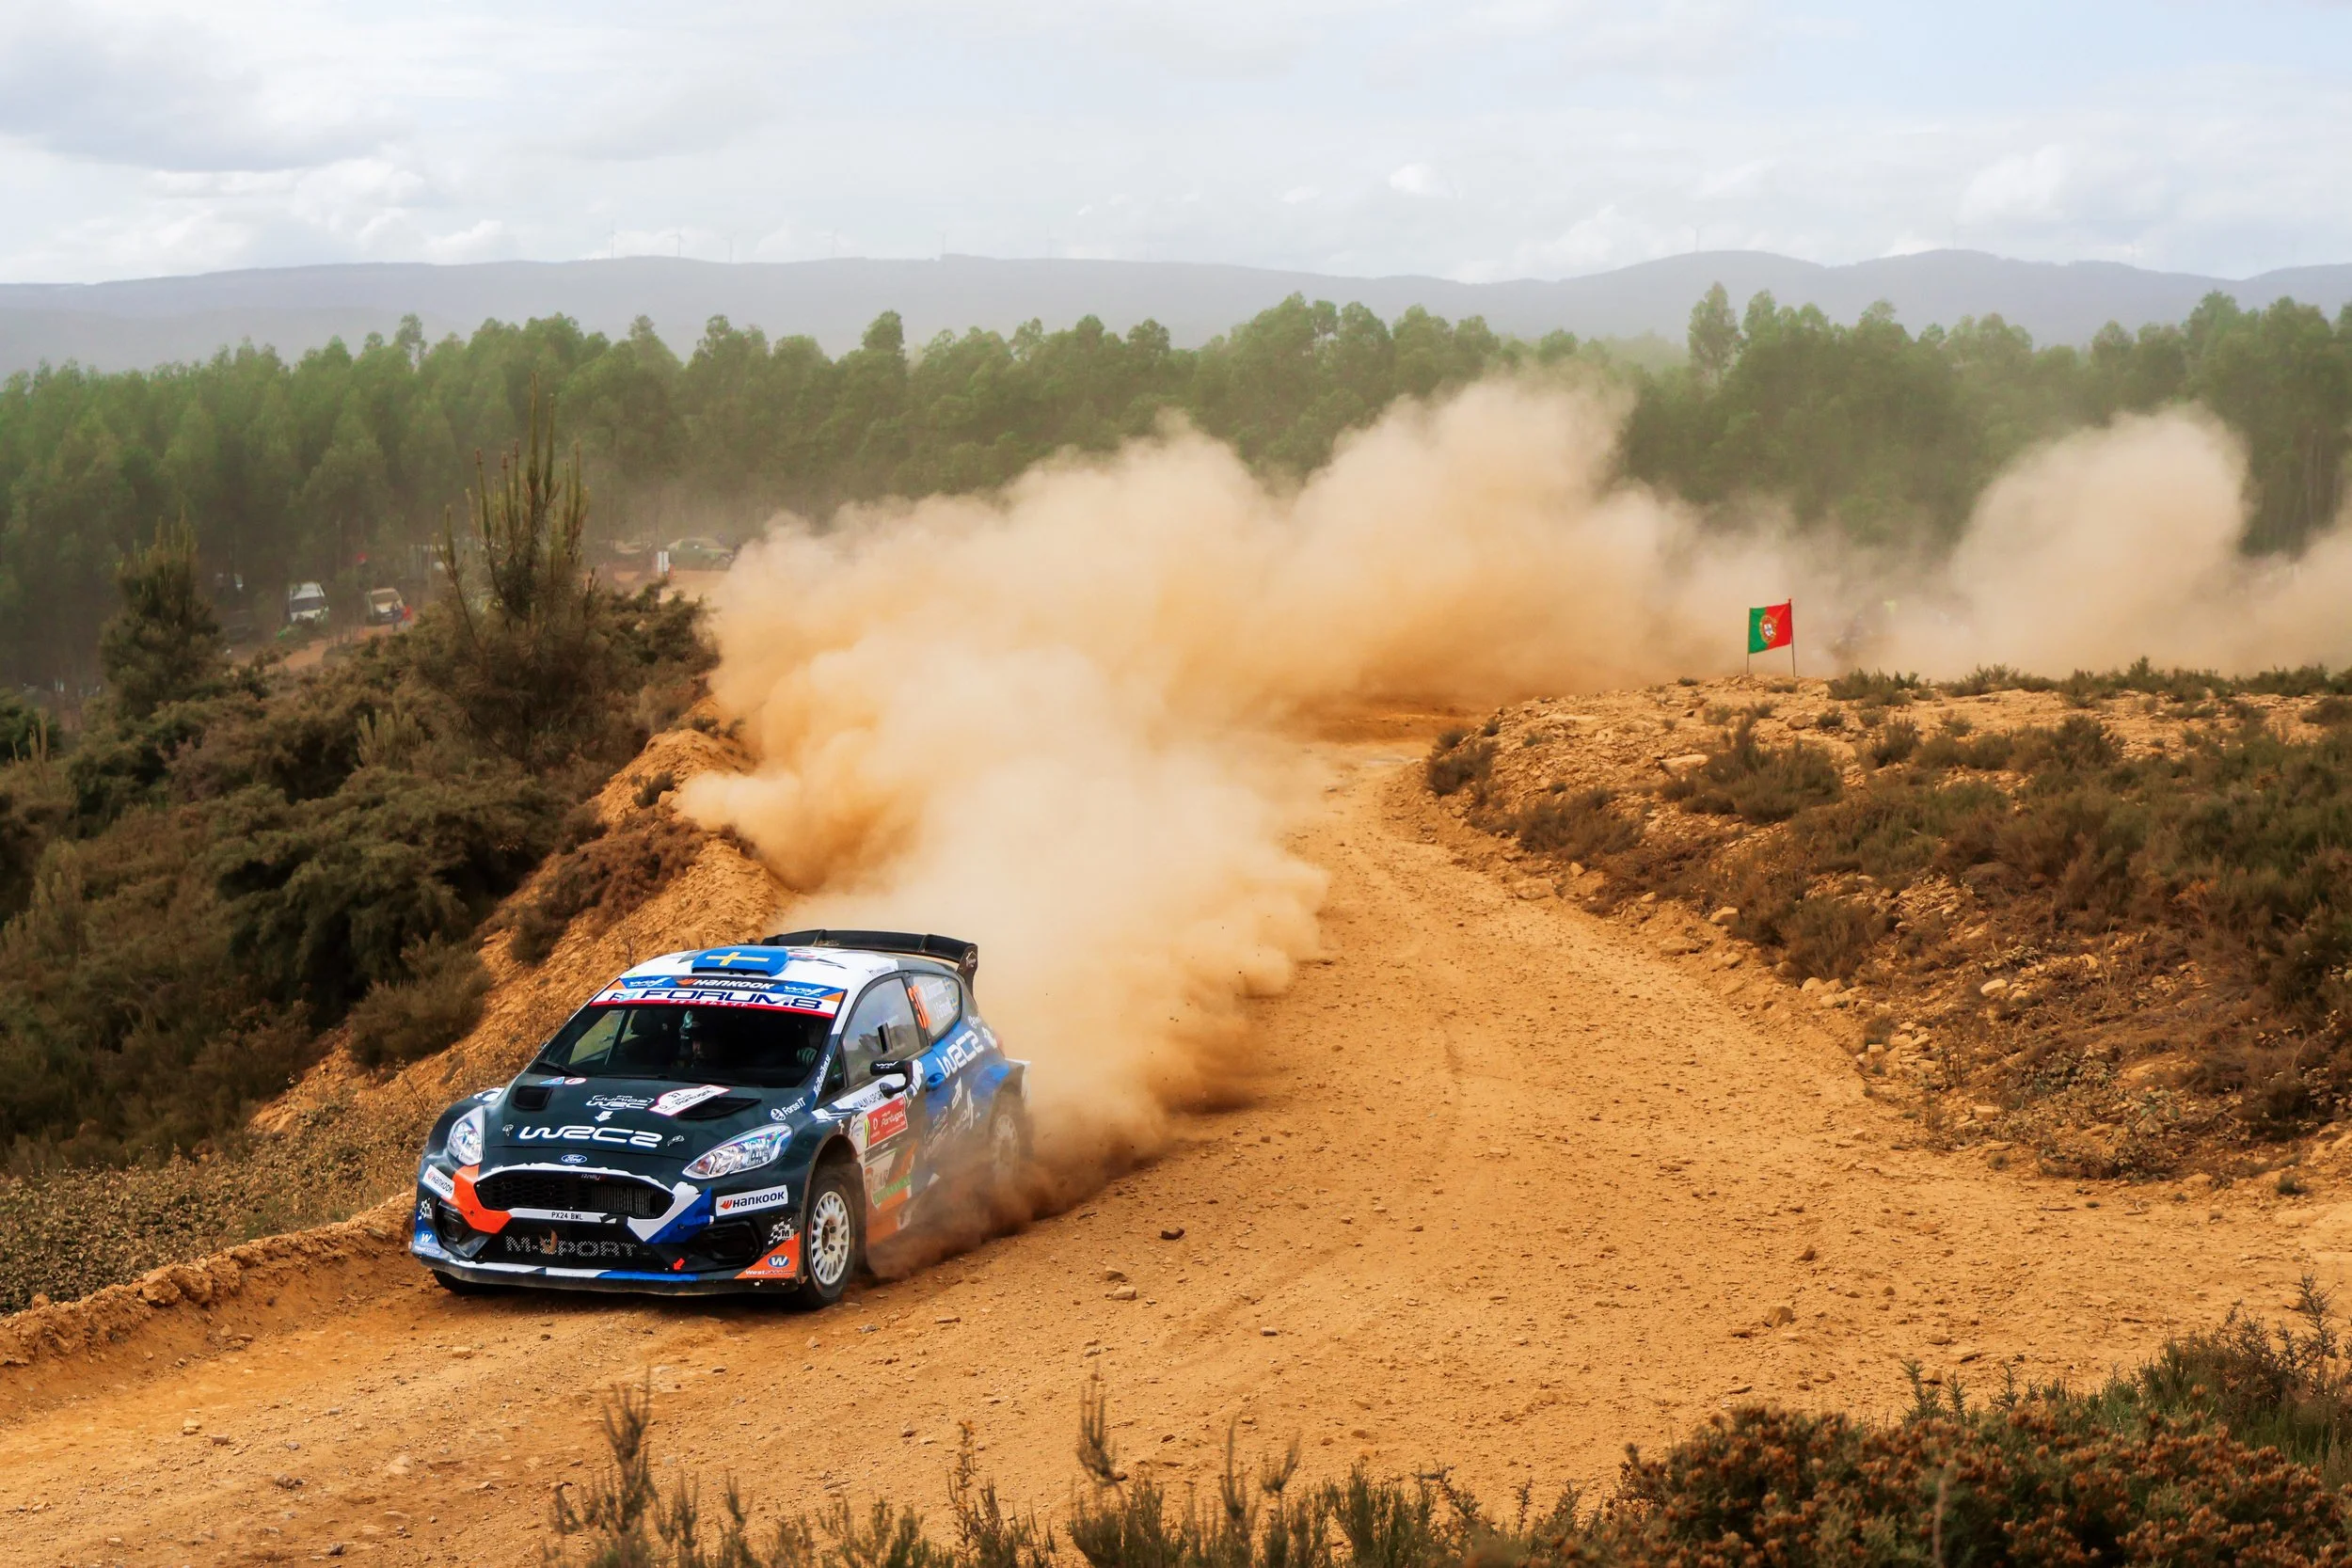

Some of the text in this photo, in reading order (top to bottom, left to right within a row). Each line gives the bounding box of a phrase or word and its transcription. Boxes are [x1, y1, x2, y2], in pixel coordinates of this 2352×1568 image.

[640, 990, 822, 1010] FORUM8
[935, 1030, 984, 1079] WRC2
[518, 1125, 663, 1148] WRC2
